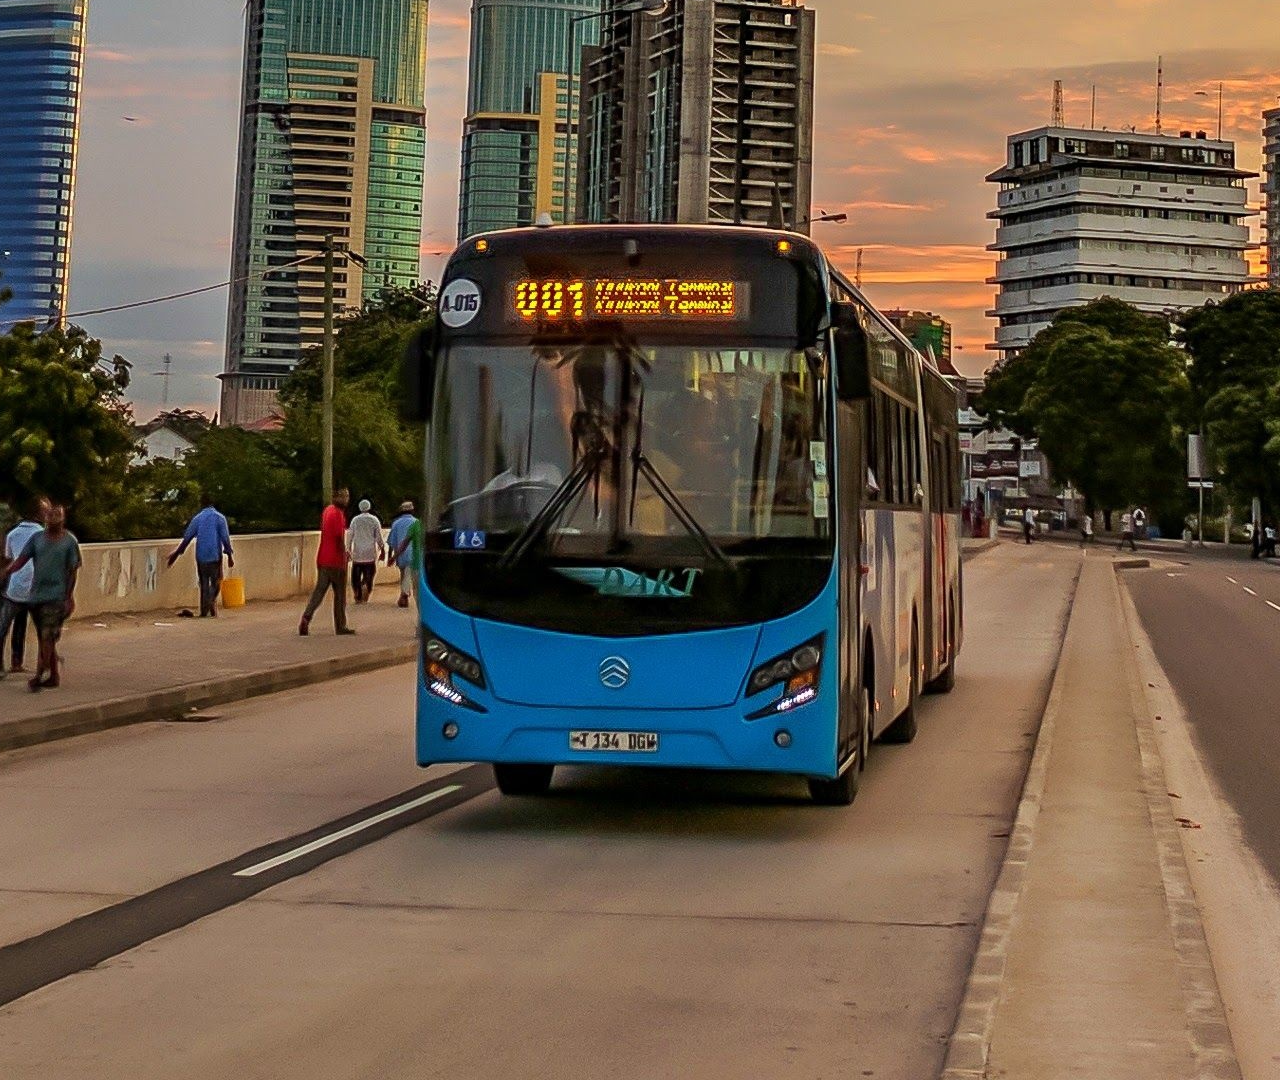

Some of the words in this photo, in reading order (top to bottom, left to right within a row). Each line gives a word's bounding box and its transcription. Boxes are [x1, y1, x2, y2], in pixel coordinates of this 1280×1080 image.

[442, 293, 478, 312] A-015
[515, 282, 583, 317] 001
[600, 567, 703, 597] DART
[592, 733, 620, 749] 134
